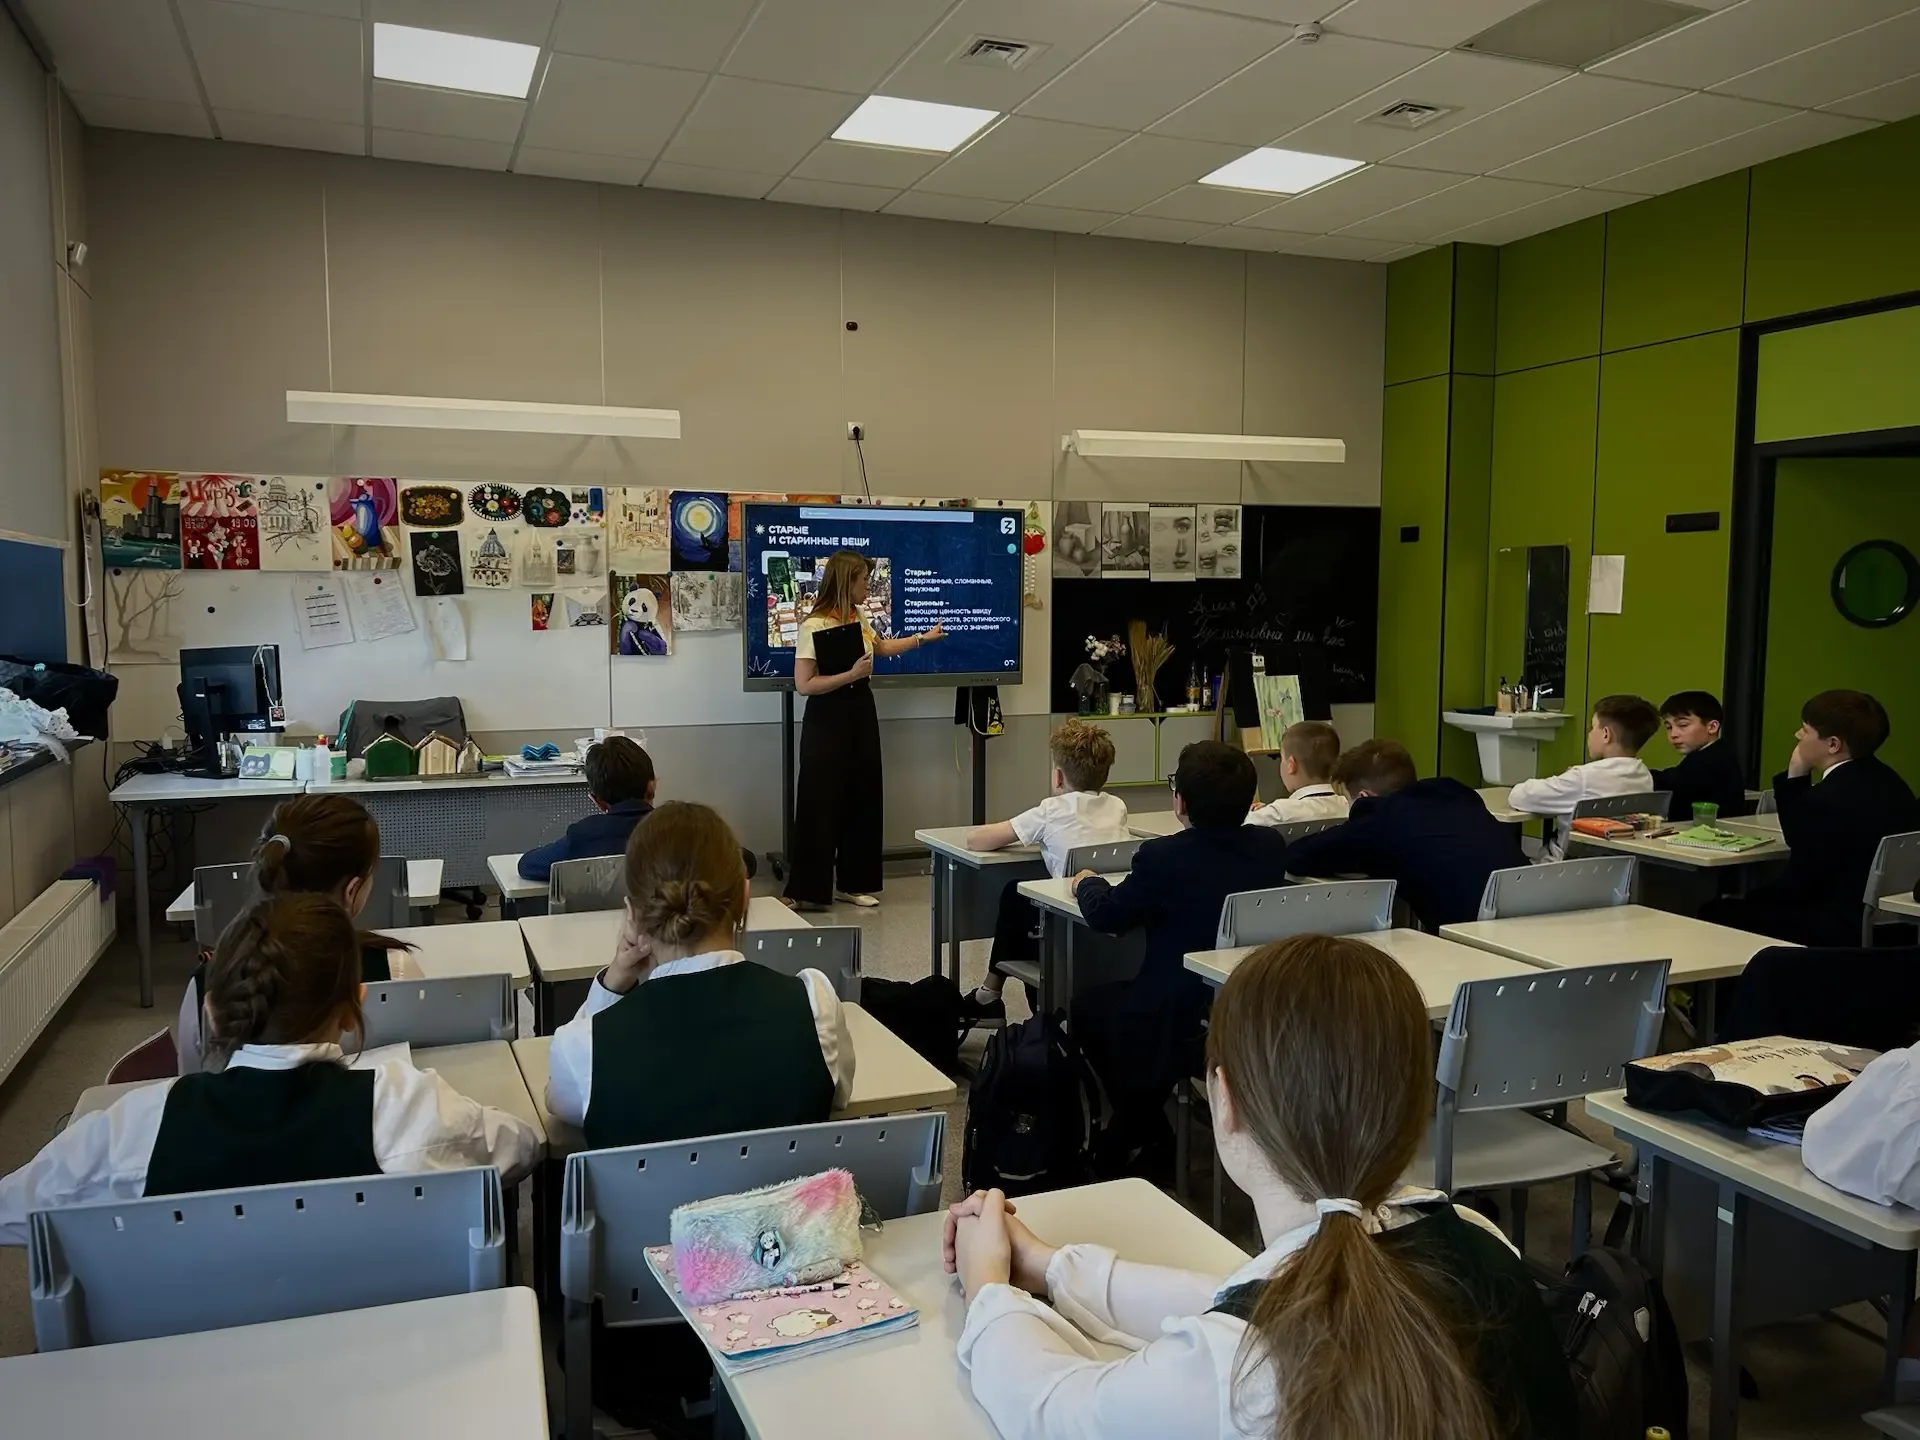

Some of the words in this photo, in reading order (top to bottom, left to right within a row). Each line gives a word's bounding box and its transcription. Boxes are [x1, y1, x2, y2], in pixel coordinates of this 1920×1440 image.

[768, 525, 809, 535] СТАРЫЕ
[769, 536, 776, 545] И
[779, 536, 839, 545] СТАРИННЫЕ
[842, 537, 870, 547] ВЕЩИ
[904, 599, 944, 607] Старинные
